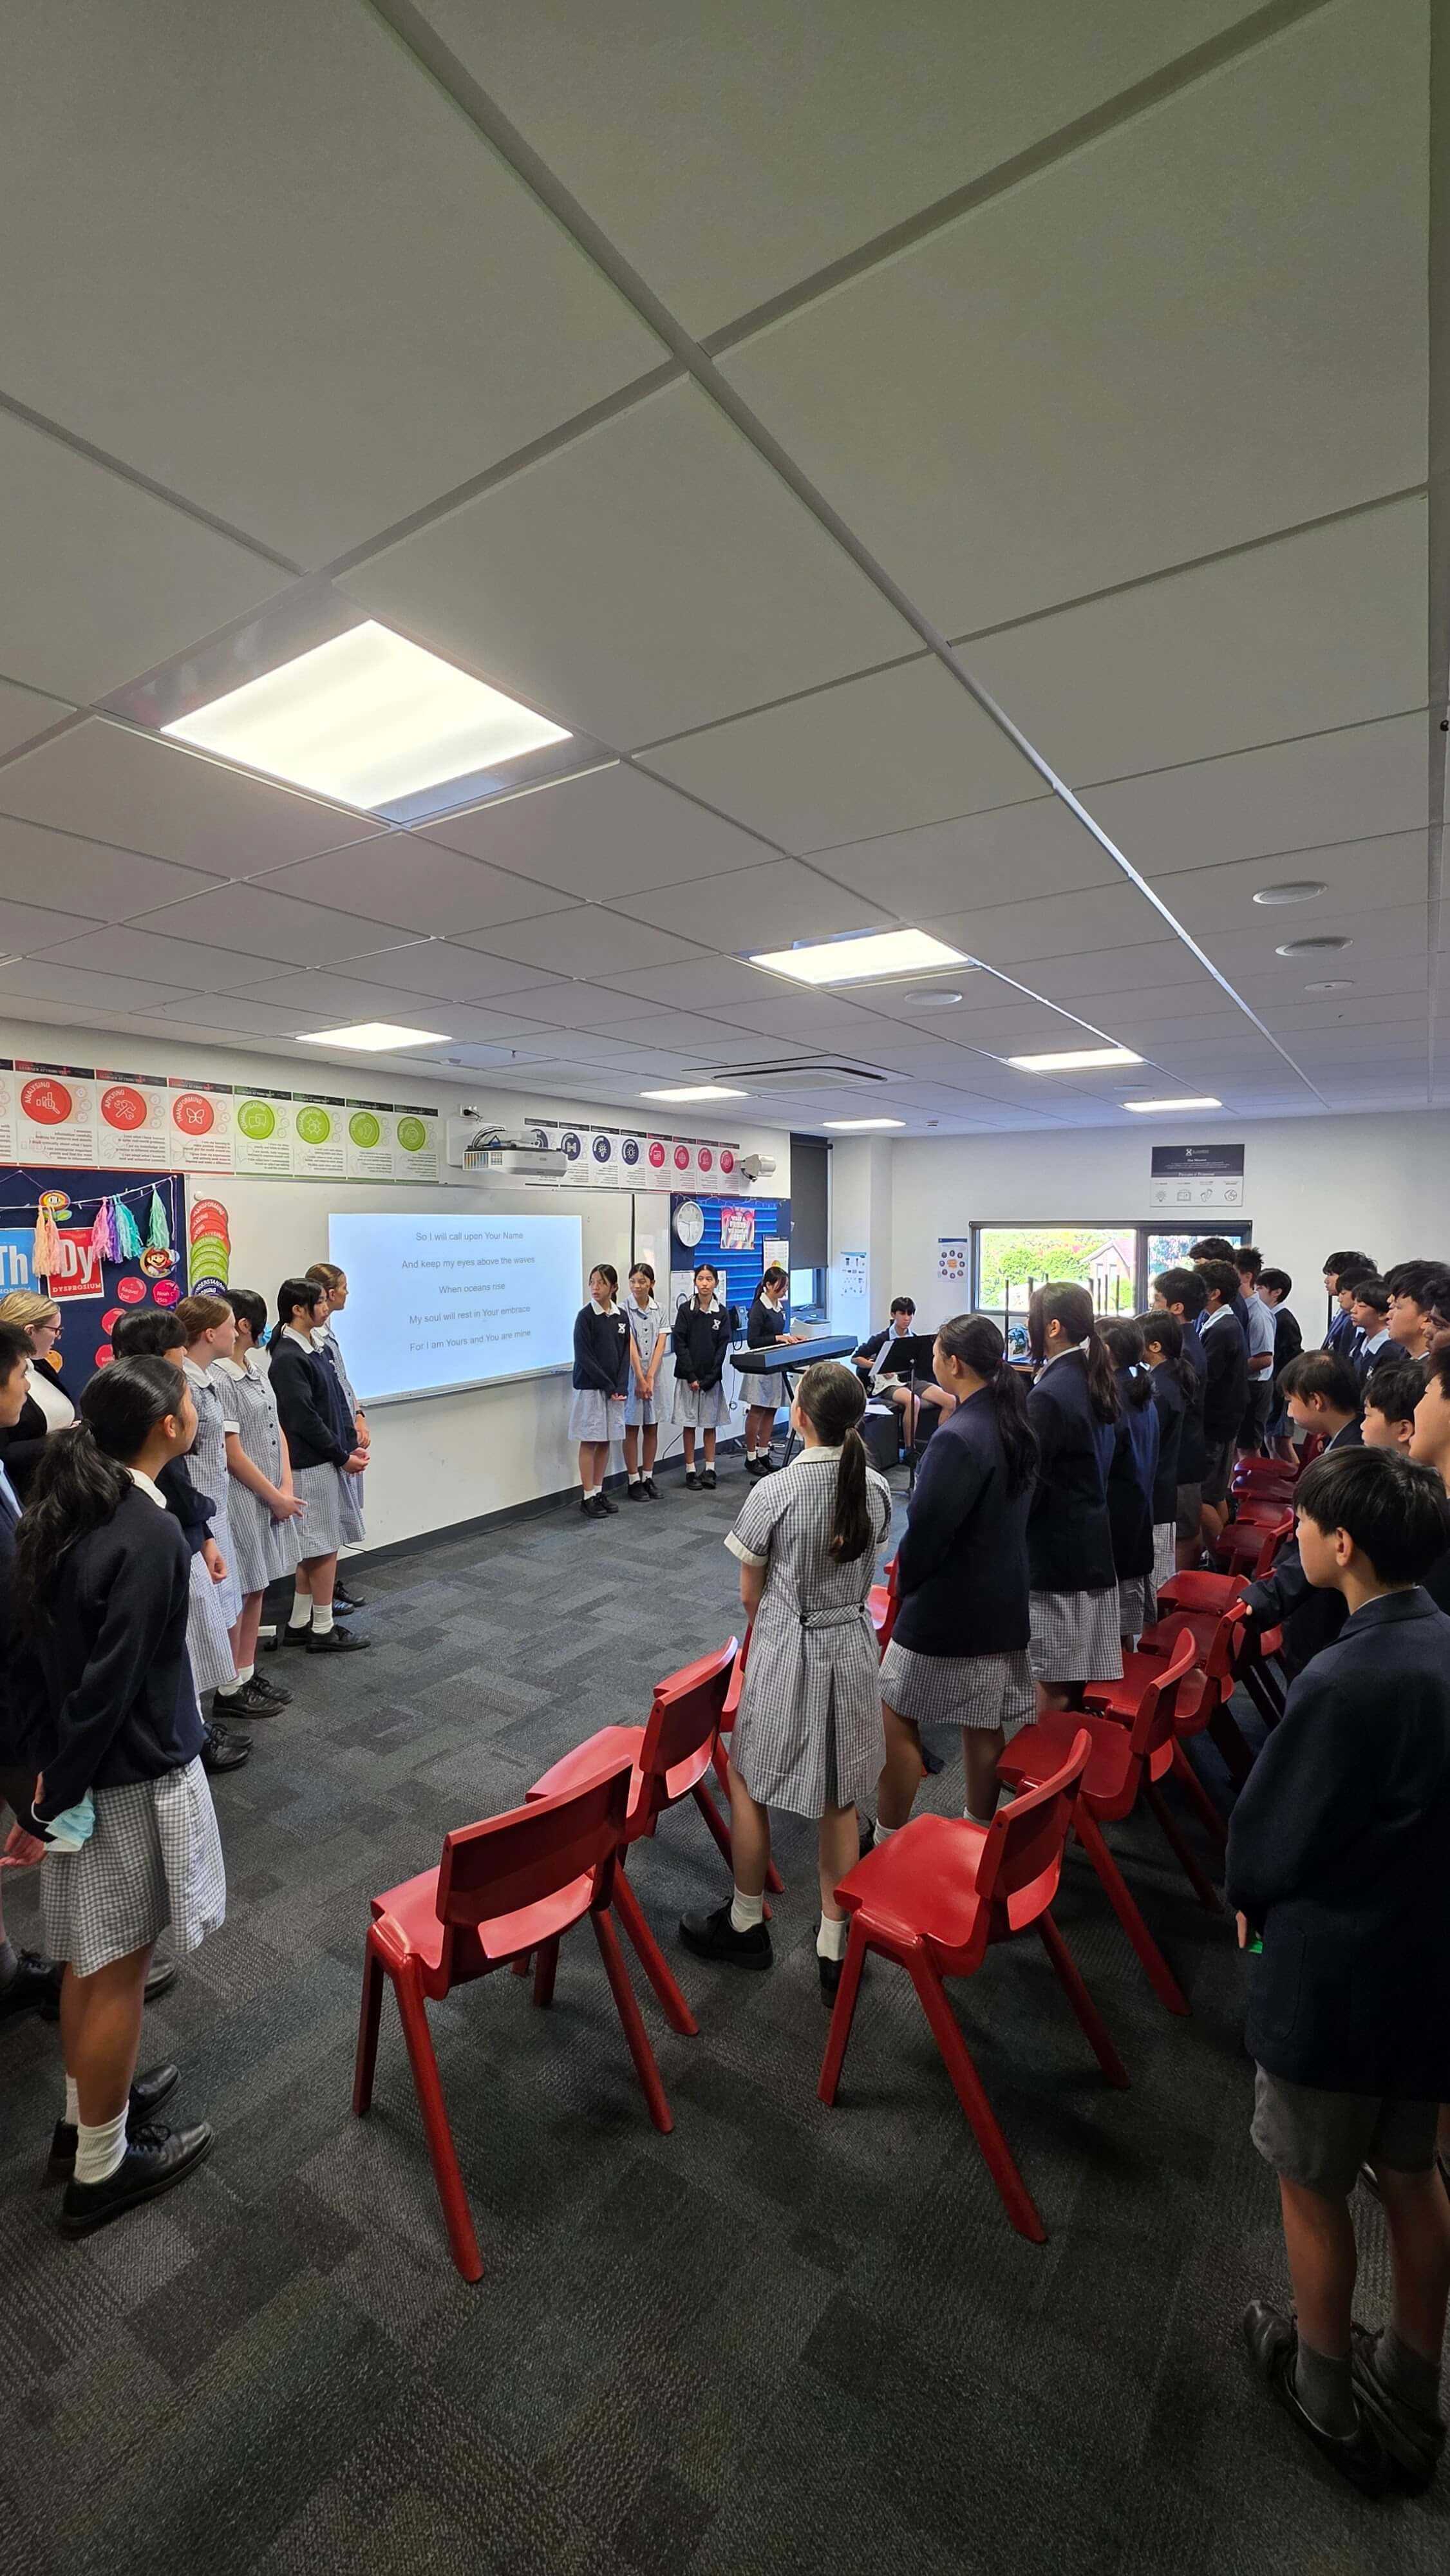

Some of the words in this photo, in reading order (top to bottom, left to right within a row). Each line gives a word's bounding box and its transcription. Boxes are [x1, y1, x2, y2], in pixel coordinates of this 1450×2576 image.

[24, 1081, 51, 1104] ANALYSING
[104, 1089, 125, 1108] APPLYING
[416, 1232, 427, 1241] So
[429, 1232, 432, 1241] I
[435, 1232, 447, 1241] will
[449, 1232, 462, 1240] call
[464, 1233, 483, 1242] upon
[485, 1231, 500, 1240] Your
[503, 1231, 523, 1240] Name
[57, 1239, 93, 1284] Dy
[402, 1260, 419, 1269] And
[421, 1260, 440, 1269] keep
[443, 1260, 455, 1269] my
[457, 1260, 475, 1268] eyes
[52, 1283, 101, 1293] DYSPROSIUM
[438, 1285, 462, 1294] When
[464, 1284, 491, 1293] oceans
[410, 1315, 422, 1325] My
[424, 1313, 441, 1322] soul
[443, 1312, 456, 1320] will
[482, 1309, 500, 1317] Your
[500, 1306, 531, 1314] embrace
[410, 1343, 424, 1351] For
[446, 1339, 467, 1347] Yours
[469, 1336, 484, 1344] and
